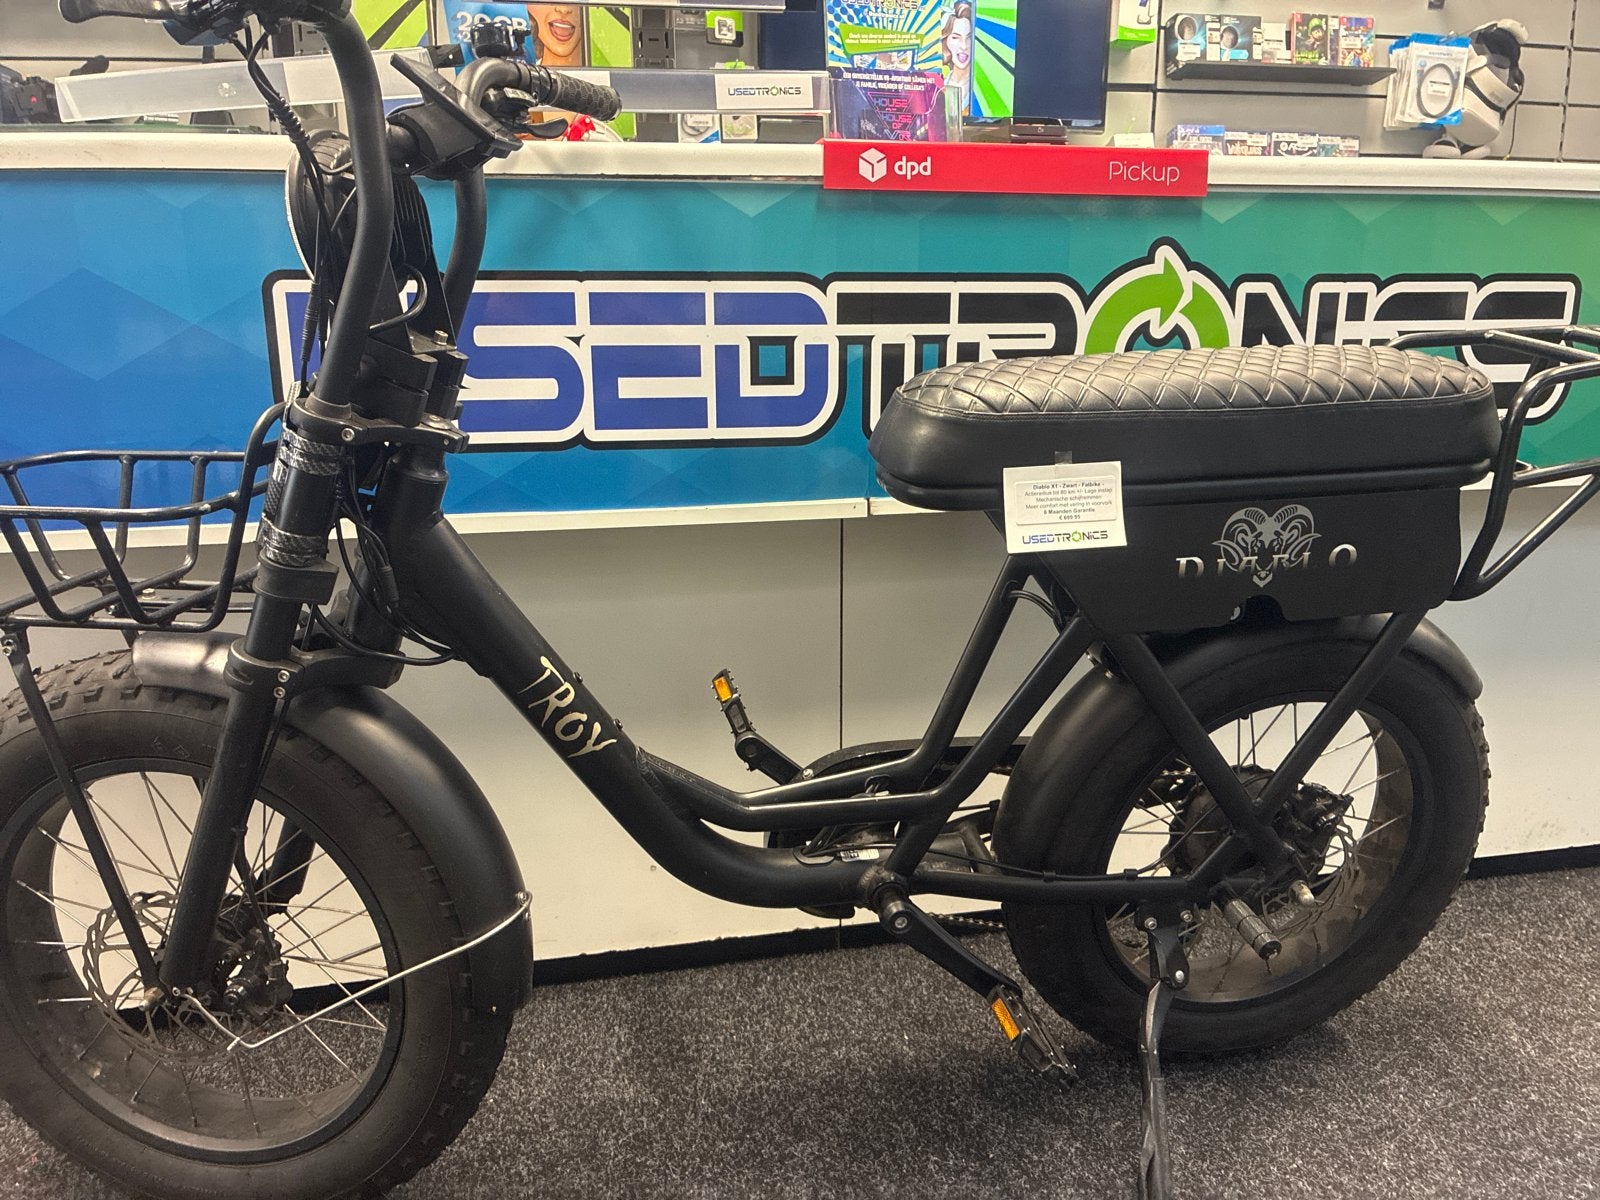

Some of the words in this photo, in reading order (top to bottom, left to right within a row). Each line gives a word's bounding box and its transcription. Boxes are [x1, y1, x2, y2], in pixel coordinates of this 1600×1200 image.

[874, 98, 908, 107] HOUSE
[882, 113, 912, 123] HOUSE
[894, 155, 933, 179] dpd
[1109, 160, 1181, 183] Pickup
[1176, 543, 1358, 578] DIABLO
[517, 655, 618, 758] TROY
